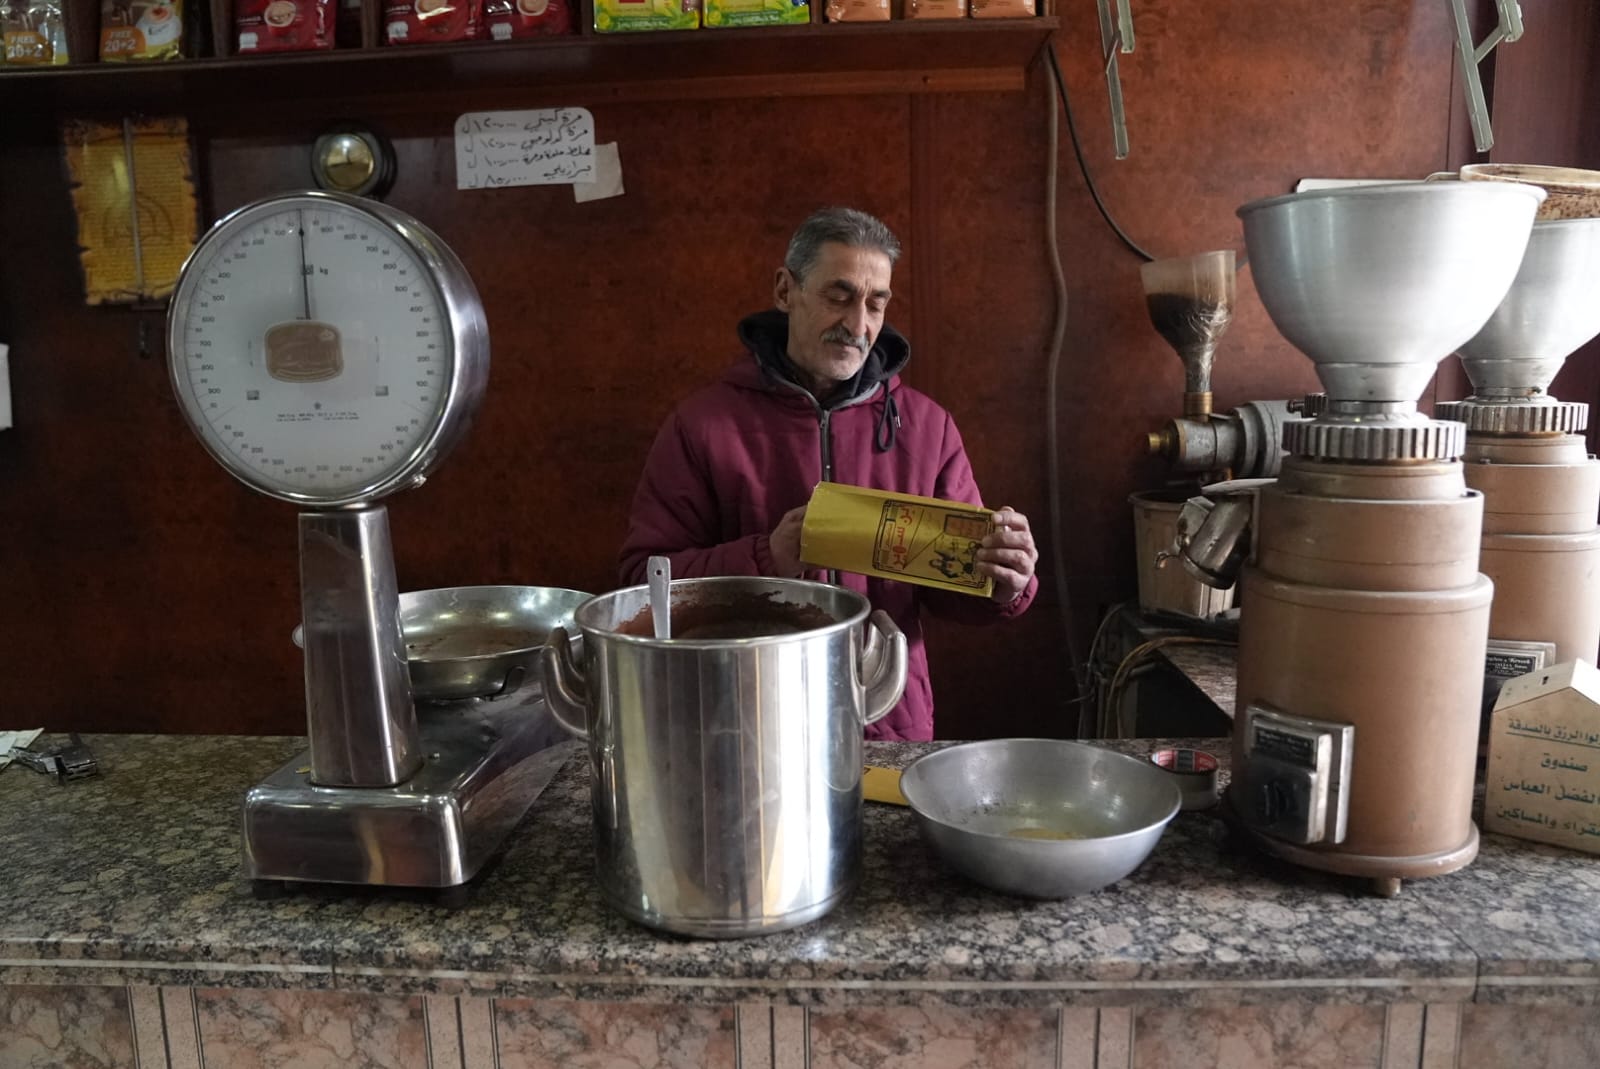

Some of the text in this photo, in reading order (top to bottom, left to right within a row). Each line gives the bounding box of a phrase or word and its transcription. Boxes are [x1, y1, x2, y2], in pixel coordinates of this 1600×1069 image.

[105, 39, 136, 52] 20+2
[1508, 718, 1551, 735] بالصدقة
[1553, 725, 1583, 741] الرزق
[1540, 752, 1588, 772] صندوق
[1503, 779, 1550, 795] العباس
[1496, 805, 1557, 829] والمساكين
